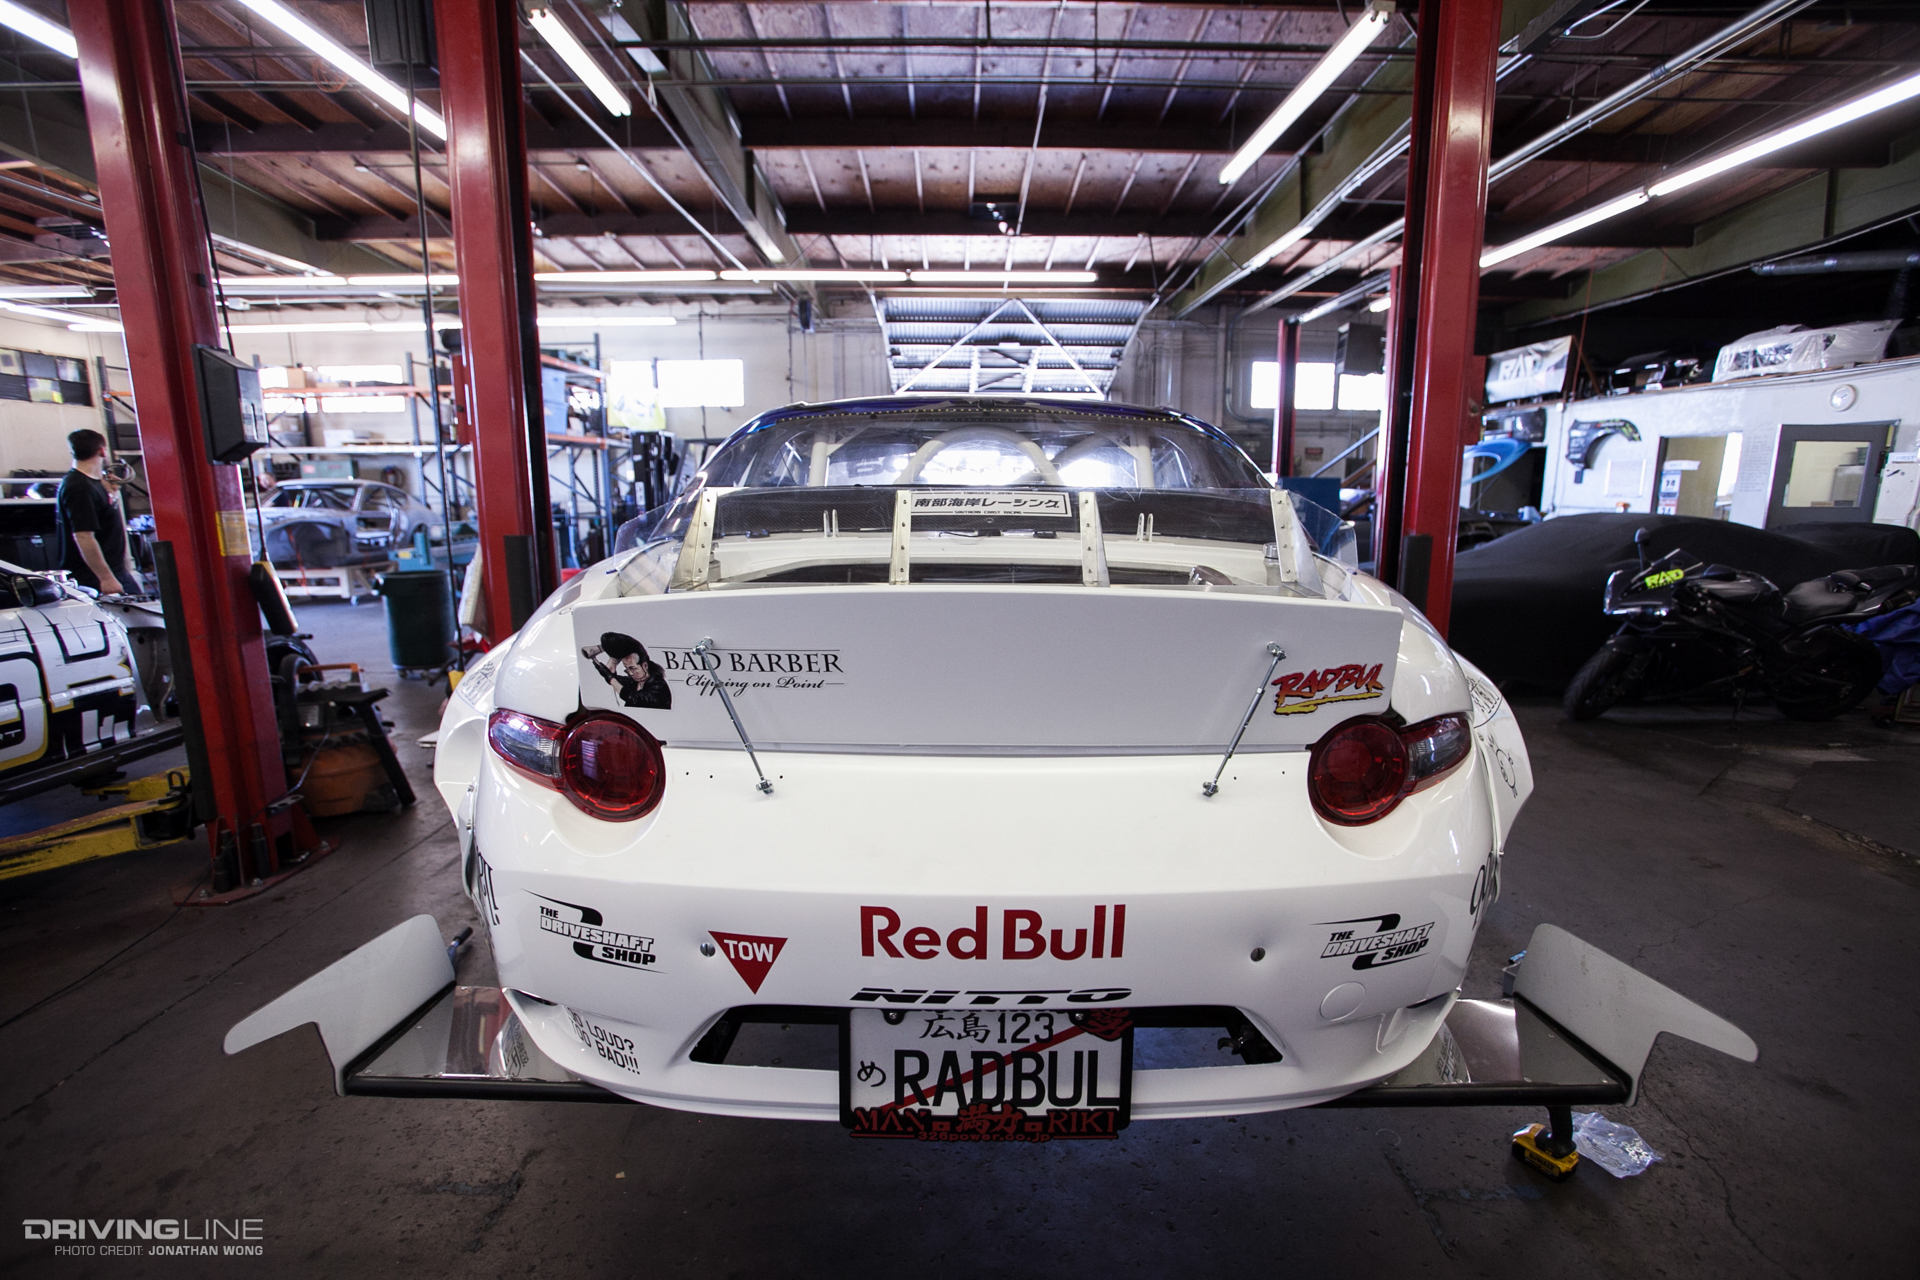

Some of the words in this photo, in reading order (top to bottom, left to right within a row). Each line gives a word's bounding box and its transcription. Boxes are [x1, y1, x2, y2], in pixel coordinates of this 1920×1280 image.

[662, 650, 721, 672] BAD
[728, 652, 844, 674] BARBER
[685, 673, 750, 698] Clipping
[752, 679, 773, 689] on
[776, 676, 825, 690] Point
[1271, 663, 1386, 707] RADBUL
[539, 905, 559, 919] THE
[540, 915, 654, 953] DRIVESHAFT
[860, 905, 988, 961] Red
[1002, 904, 1126, 961] Bull
[1320, 921, 1435, 959] DRIVESHAFT
[1330, 930, 1355, 941] THE
[602, 947, 656, 966] SHOP
[723, 939, 774, 963] TOW
[1381, 938, 1430, 961] SHOP
[850, 987, 1132, 1005] NITTO
[585, 1020, 634, 1054] LOUD?
[919, 1012, 991, 1044] 広島
[997, 1012, 1054, 1044] 123
[595, 1039, 641, 1075] BAD!!!
[857, 1060, 887, 1088] め
[894, 1049, 1121, 1108] RADBUL
[855, 1108, 928, 1132] MAN
[955, 1103, 1023, 1133] 満力
[1048, 1110, 1116, 1134] RIKI
